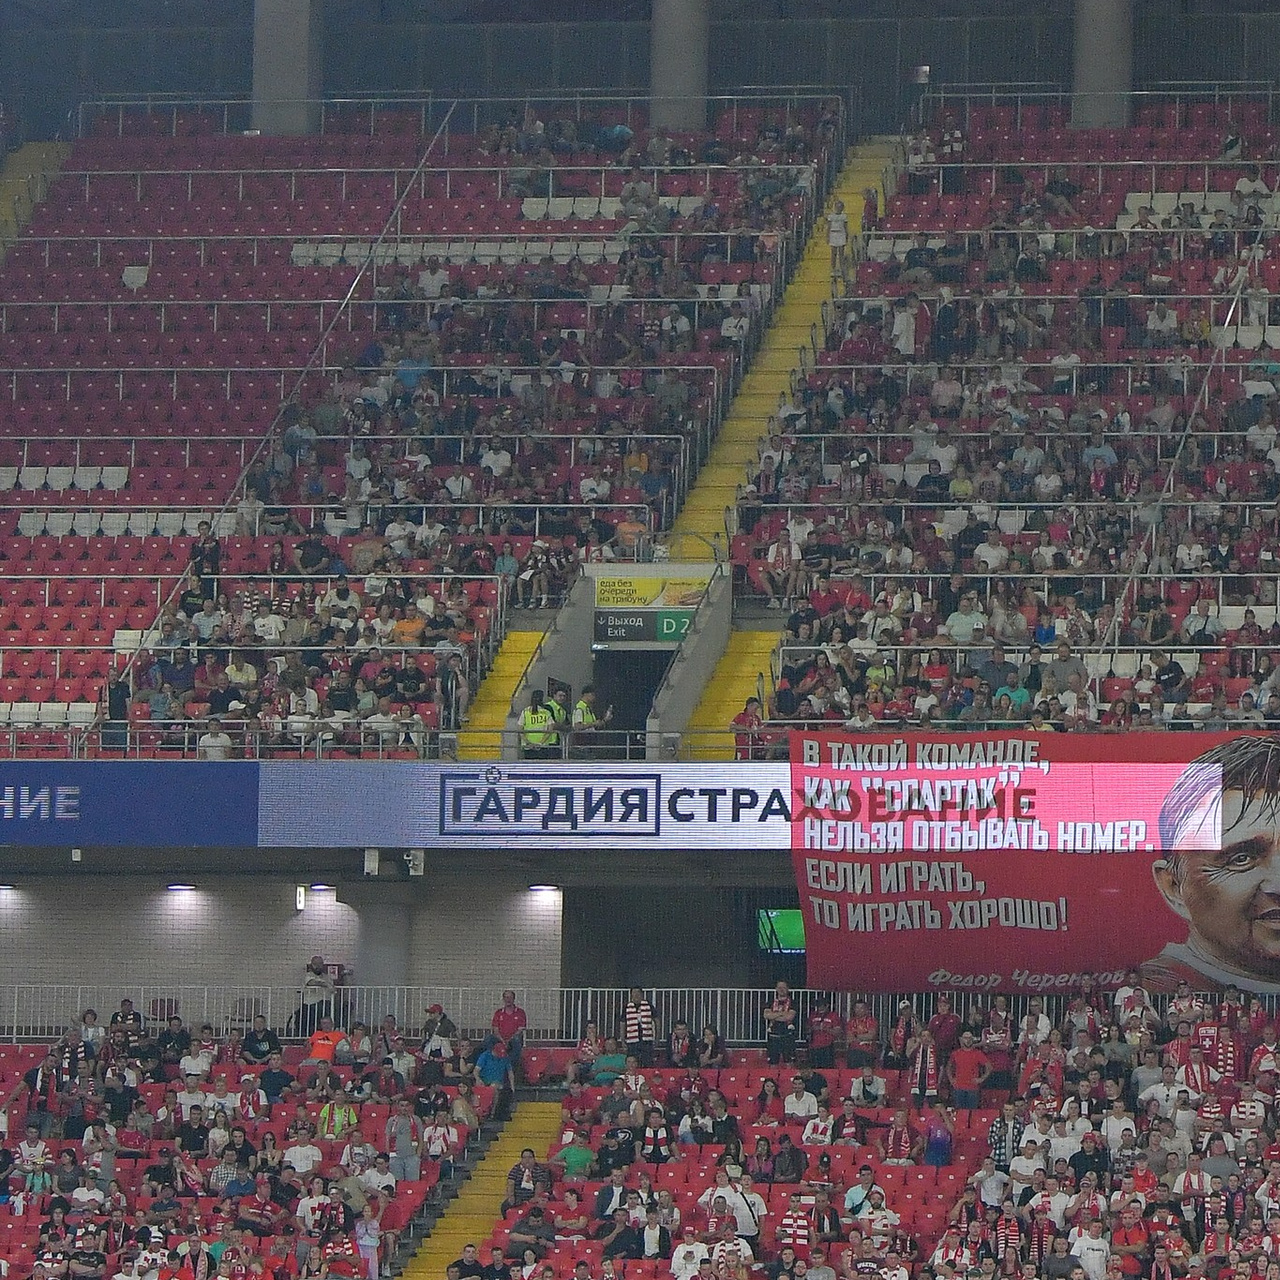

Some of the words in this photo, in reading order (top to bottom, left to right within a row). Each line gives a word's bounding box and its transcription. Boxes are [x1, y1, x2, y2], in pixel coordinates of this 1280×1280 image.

[600, 580, 616, 589] еда
[617, 578, 633, 587] без
[607, 628, 627, 637] Exit
[608, 616, 644, 627] Выход
[803, 739, 821, 767] В
[827, 738, 907, 771] ТАКОЙ
[916, 738, 1051, 776] КОМАНДЕ,
[452, 787, 648, 831] ГАРДИЯ
[803, 776, 851, 812] КАК
[803, 818, 902, 853] НЕЛЬЗЯ
[913, 819, 1050, 852] ОТБЫВАТЬ
[1056, 820, 1155, 854] НОМЕР.
[805, 858, 872, 894] ЕСЛИ
[879, 861, 986, 895] ИГРАТЬ,
[809, 895, 840, 929] ТО
[847, 899, 941, 932] ИГРАТЬ
[948, 897, 1069, 932] ХОРОШО!
